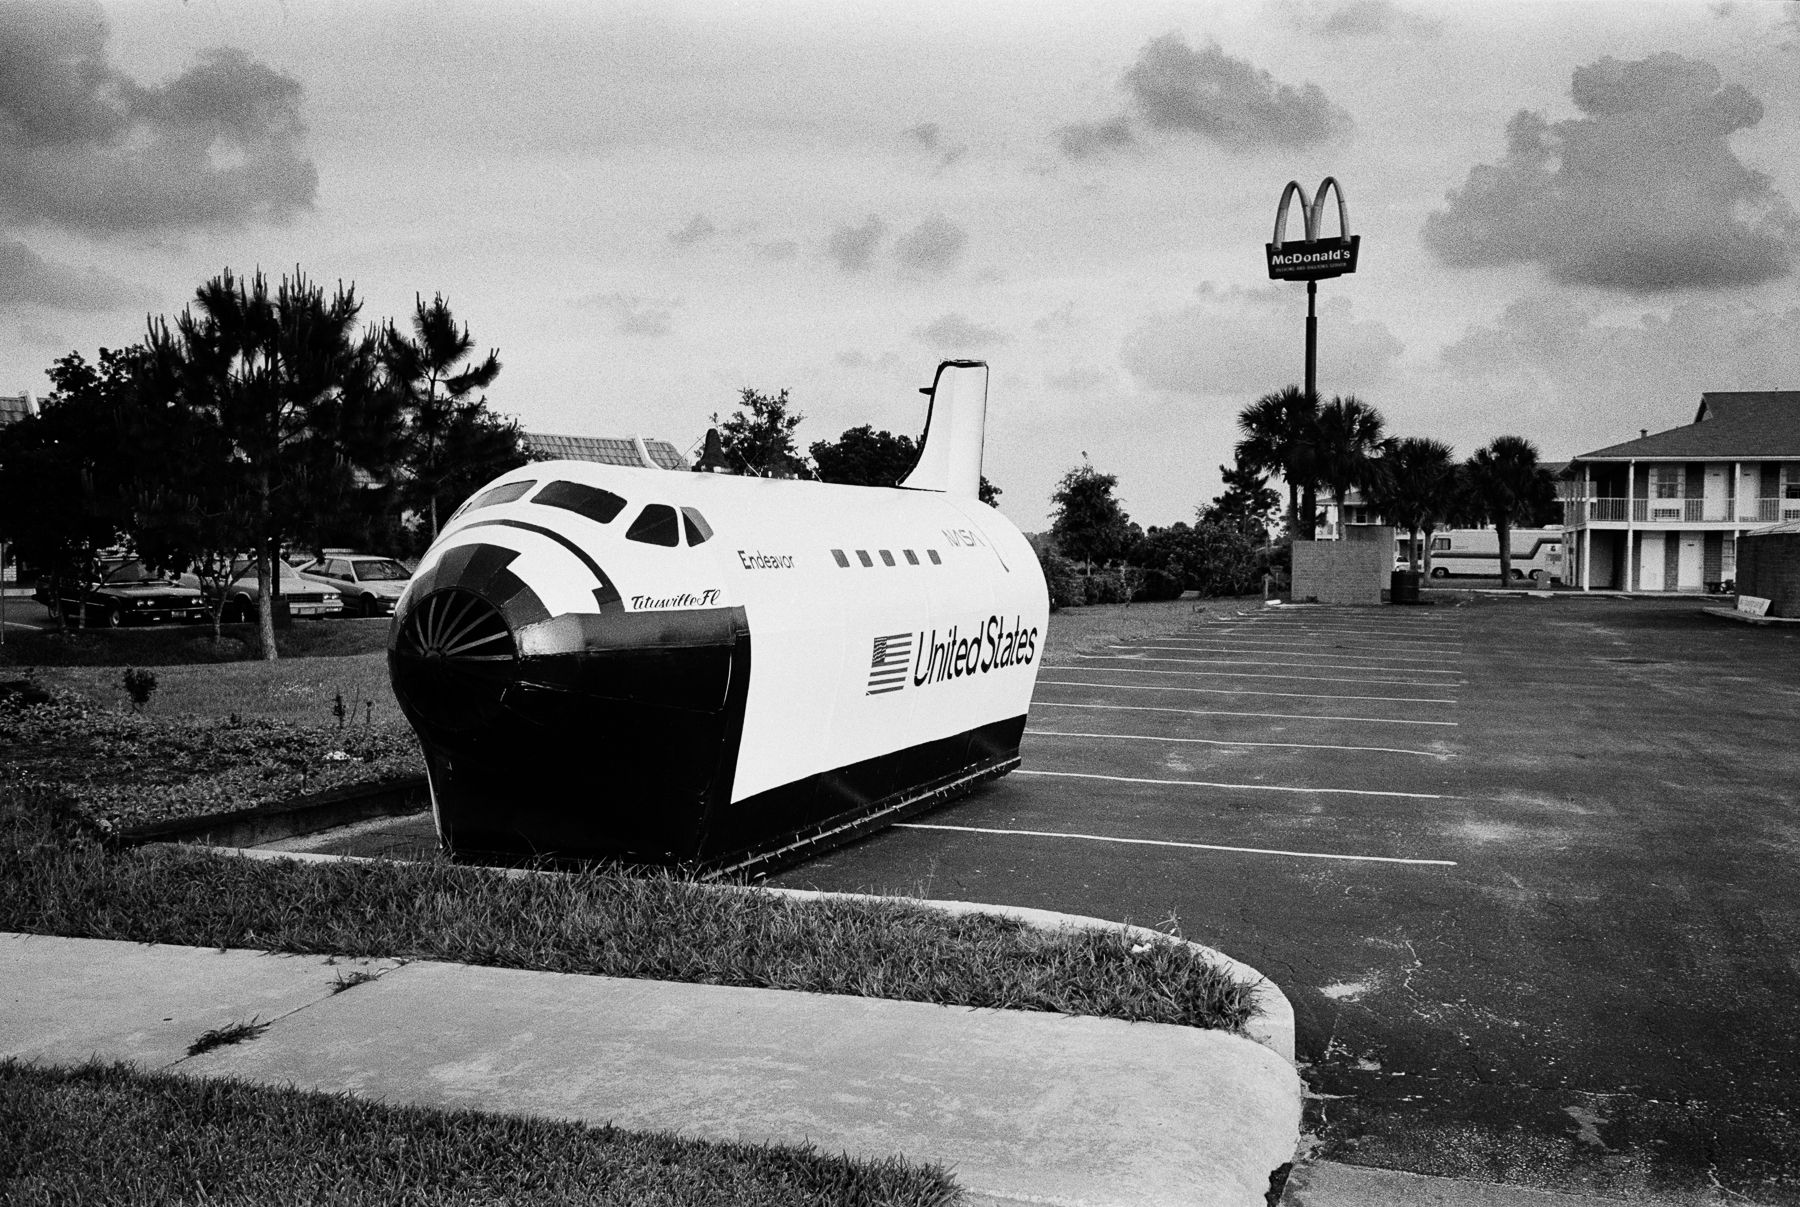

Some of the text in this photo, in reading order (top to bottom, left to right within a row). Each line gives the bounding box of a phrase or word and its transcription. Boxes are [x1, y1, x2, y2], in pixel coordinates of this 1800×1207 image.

[1272, 249, 1350, 265] McDonald's
[941, 529, 986, 547] NASA
[737, 550, 796, 570] Endeavor
[913, 615, 1038, 687] United States
